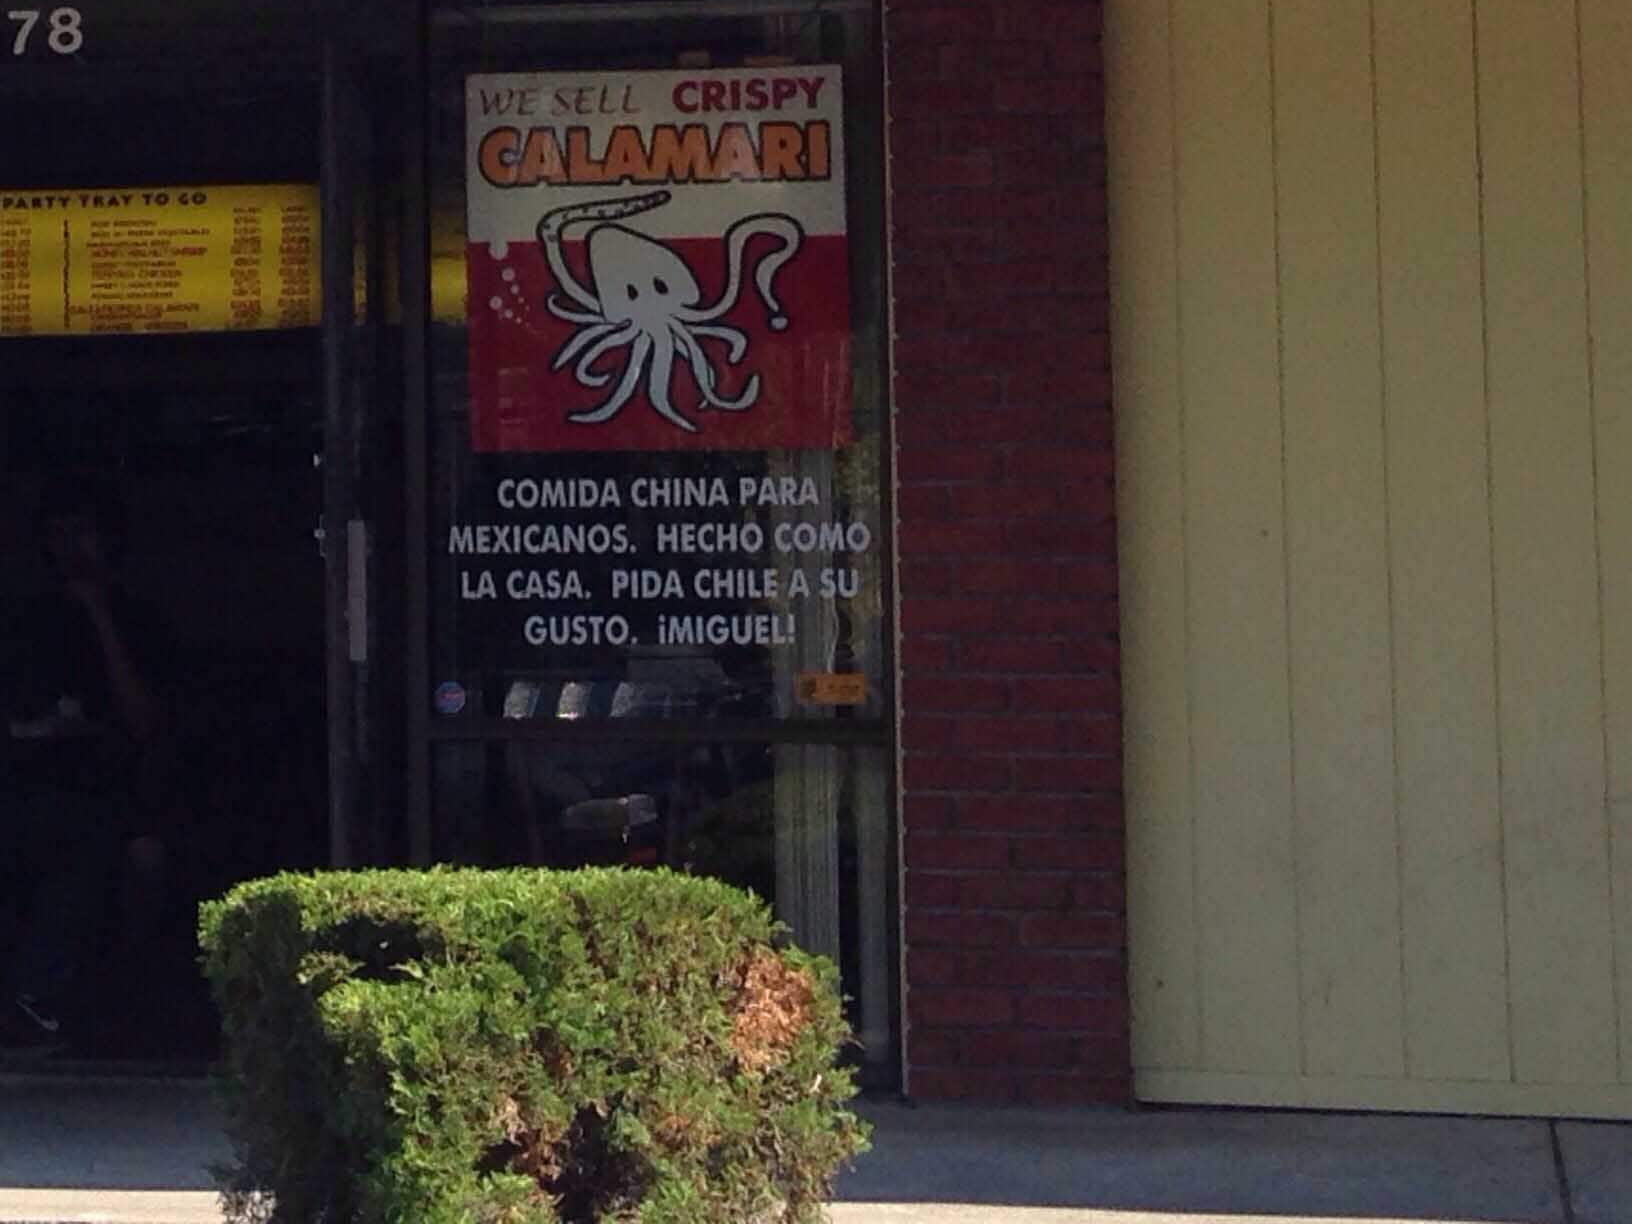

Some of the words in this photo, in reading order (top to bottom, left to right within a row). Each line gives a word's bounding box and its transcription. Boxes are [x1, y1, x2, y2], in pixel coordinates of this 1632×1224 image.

[479, 87, 541, 116] WE
[553, 86, 641, 115] SELL
[672, 78, 825, 113] CRISPY
[478, 120, 831, 187] CALAMARI
[2, 194, 70, 209] PARTY
[80, 192, 133, 207] TRAY
[142, 191, 169, 206] TO
[178, 190, 208, 206] GO
[497, 478, 620, 508] COMIDA
[630, 477, 729, 507] CHINA
[739, 477, 819, 506] PARA
[448, 524, 637, 553] MEXICANOS.
[657, 523, 763, 552] HECHO
[774, 522, 870, 552] COMO
[461, 571, 496, 600] LA
[506, 570, 592, 599] CASA.
[612, 570, 684, 598] PIDA
[694, 569, 777, 598] CHILE
[788, 569, 810, 598] A
[819, 569, 859, 598] SU
[524, 616, 638, 645] GUSTO.
[658, 614, 796, 645] ¡MIGUEL!
